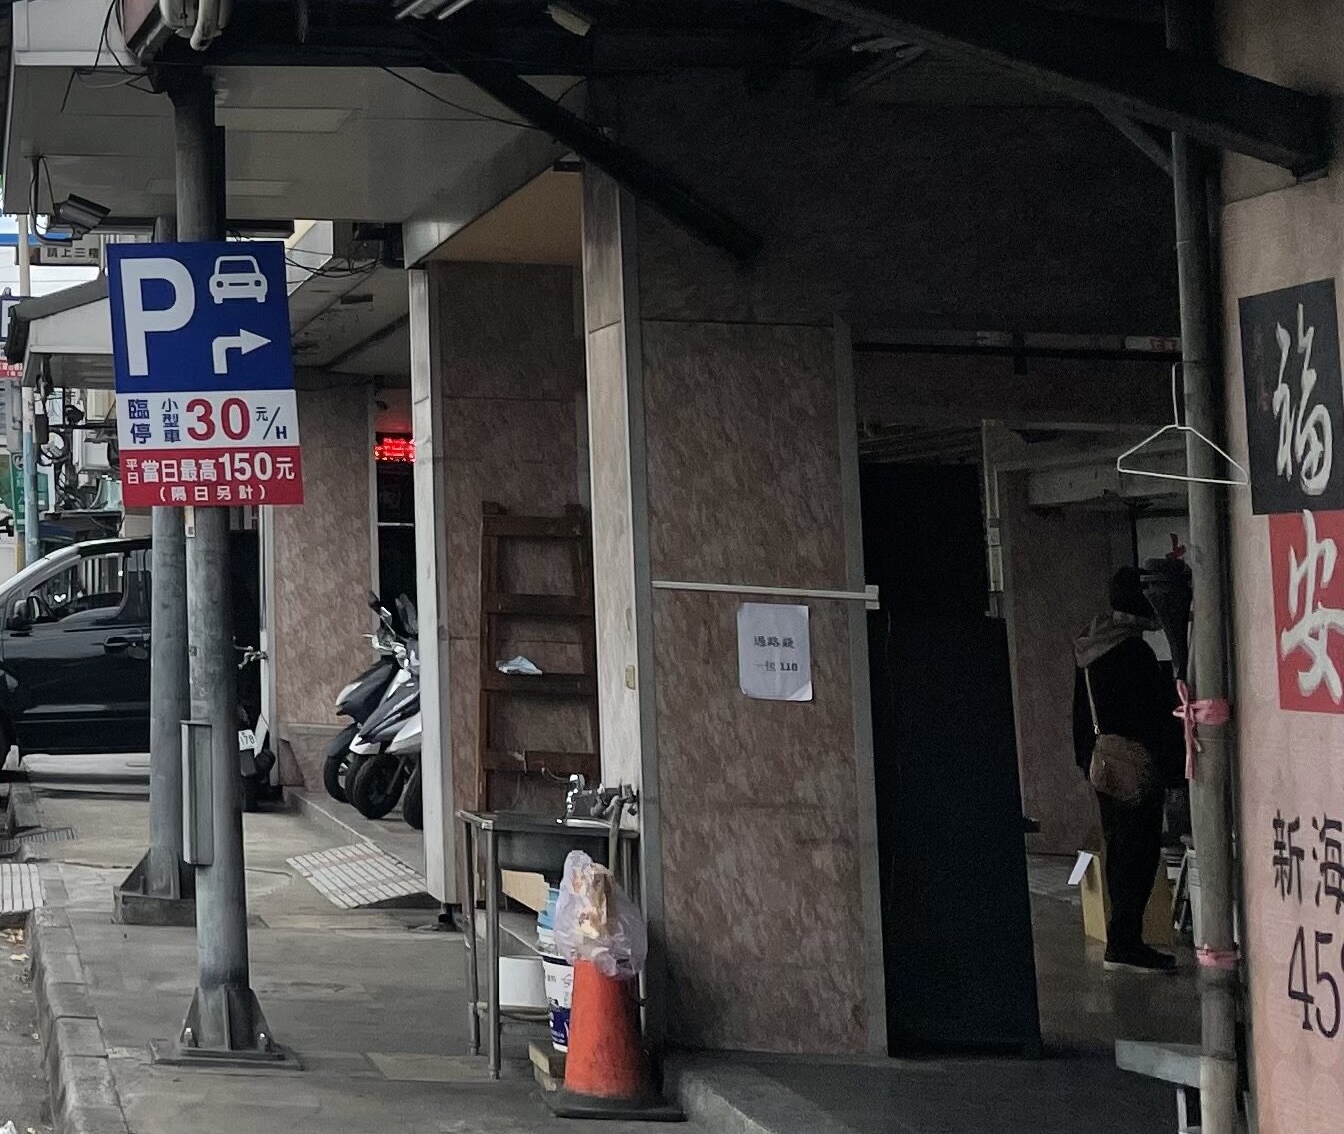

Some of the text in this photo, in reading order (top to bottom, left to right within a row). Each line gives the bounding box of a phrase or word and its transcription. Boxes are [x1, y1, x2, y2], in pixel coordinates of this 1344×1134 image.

[120, 257, 195, 376] P
[128, 399, 152, 444] 臨停
[162, 398, 181, 443] 小型車
[126, 458, 140, 485] 平日
[1288, 926, 1344, 1038] 45
